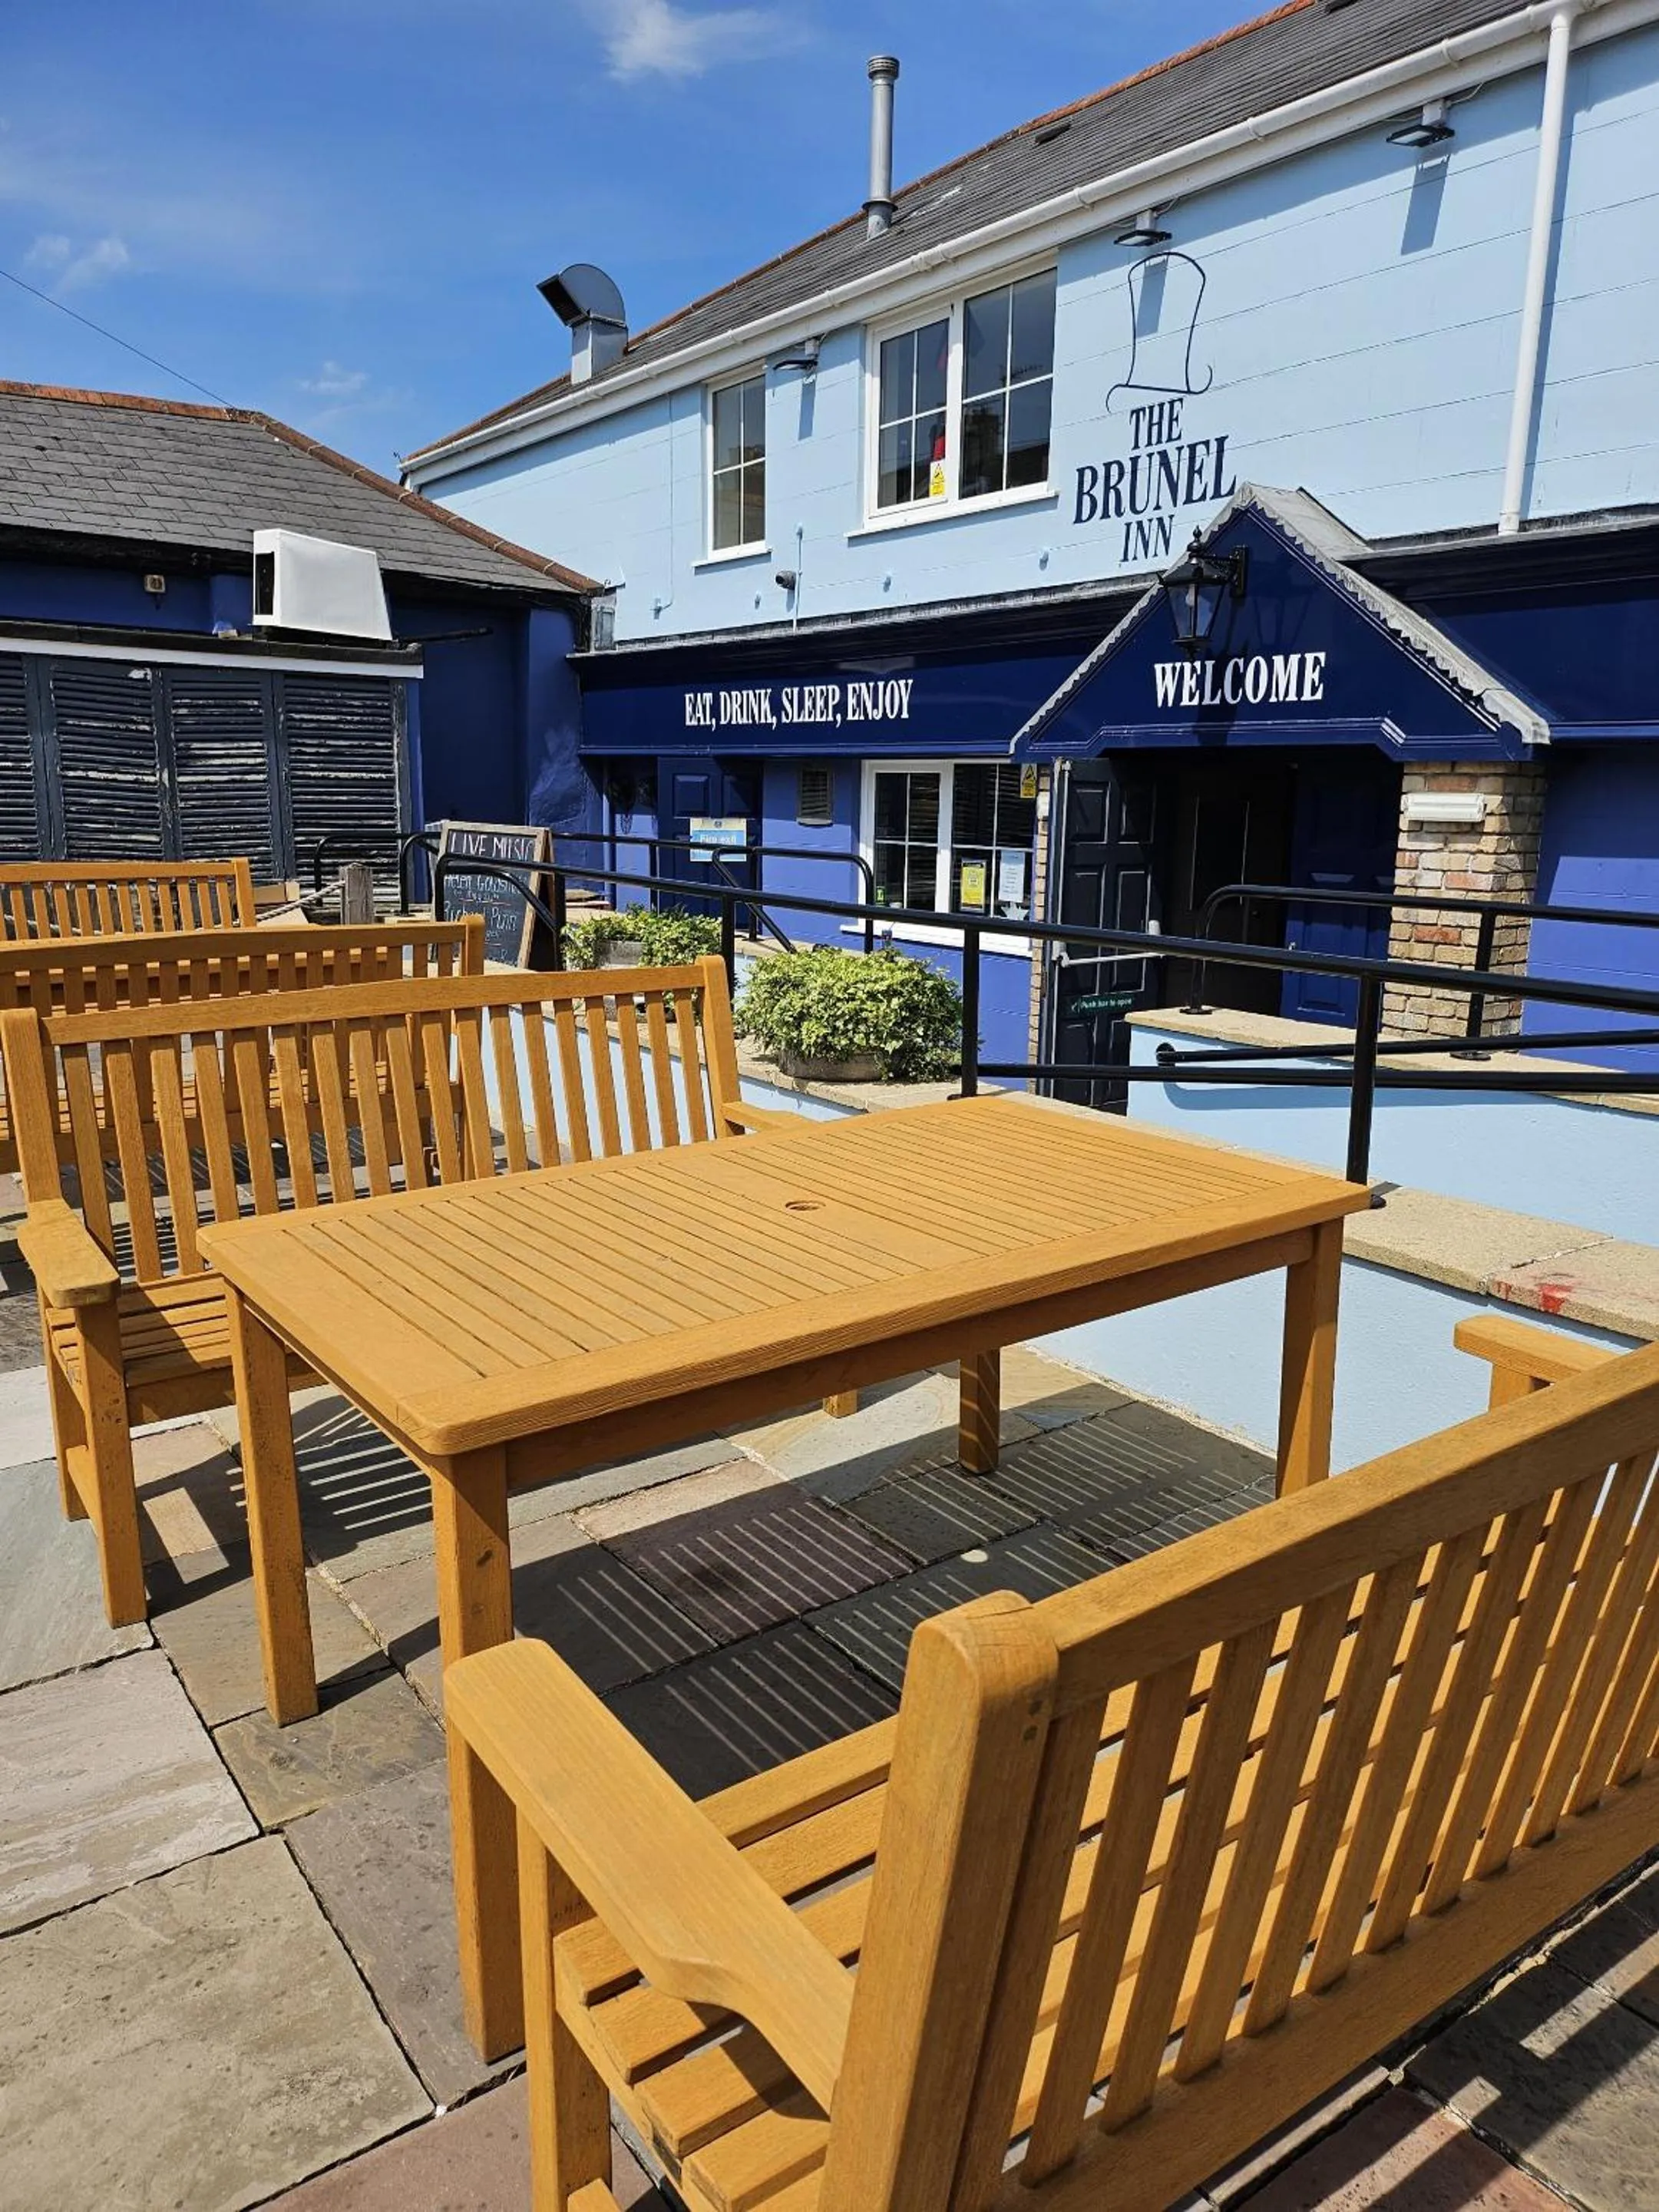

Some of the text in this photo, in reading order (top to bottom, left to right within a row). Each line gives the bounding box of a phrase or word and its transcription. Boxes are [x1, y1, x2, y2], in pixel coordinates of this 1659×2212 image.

[1129, 398, 1184, 451] THE
[1073, 435, 1237, 524] BRUNEL
[1121, 514, 1175, 563] INN
[684, 679, 914, 732] EAT, DRINK, SLEEP, ENJOY
[1154, 651, 1327, 708] WELCOME
[451, 832, 488, 856] LIVE
